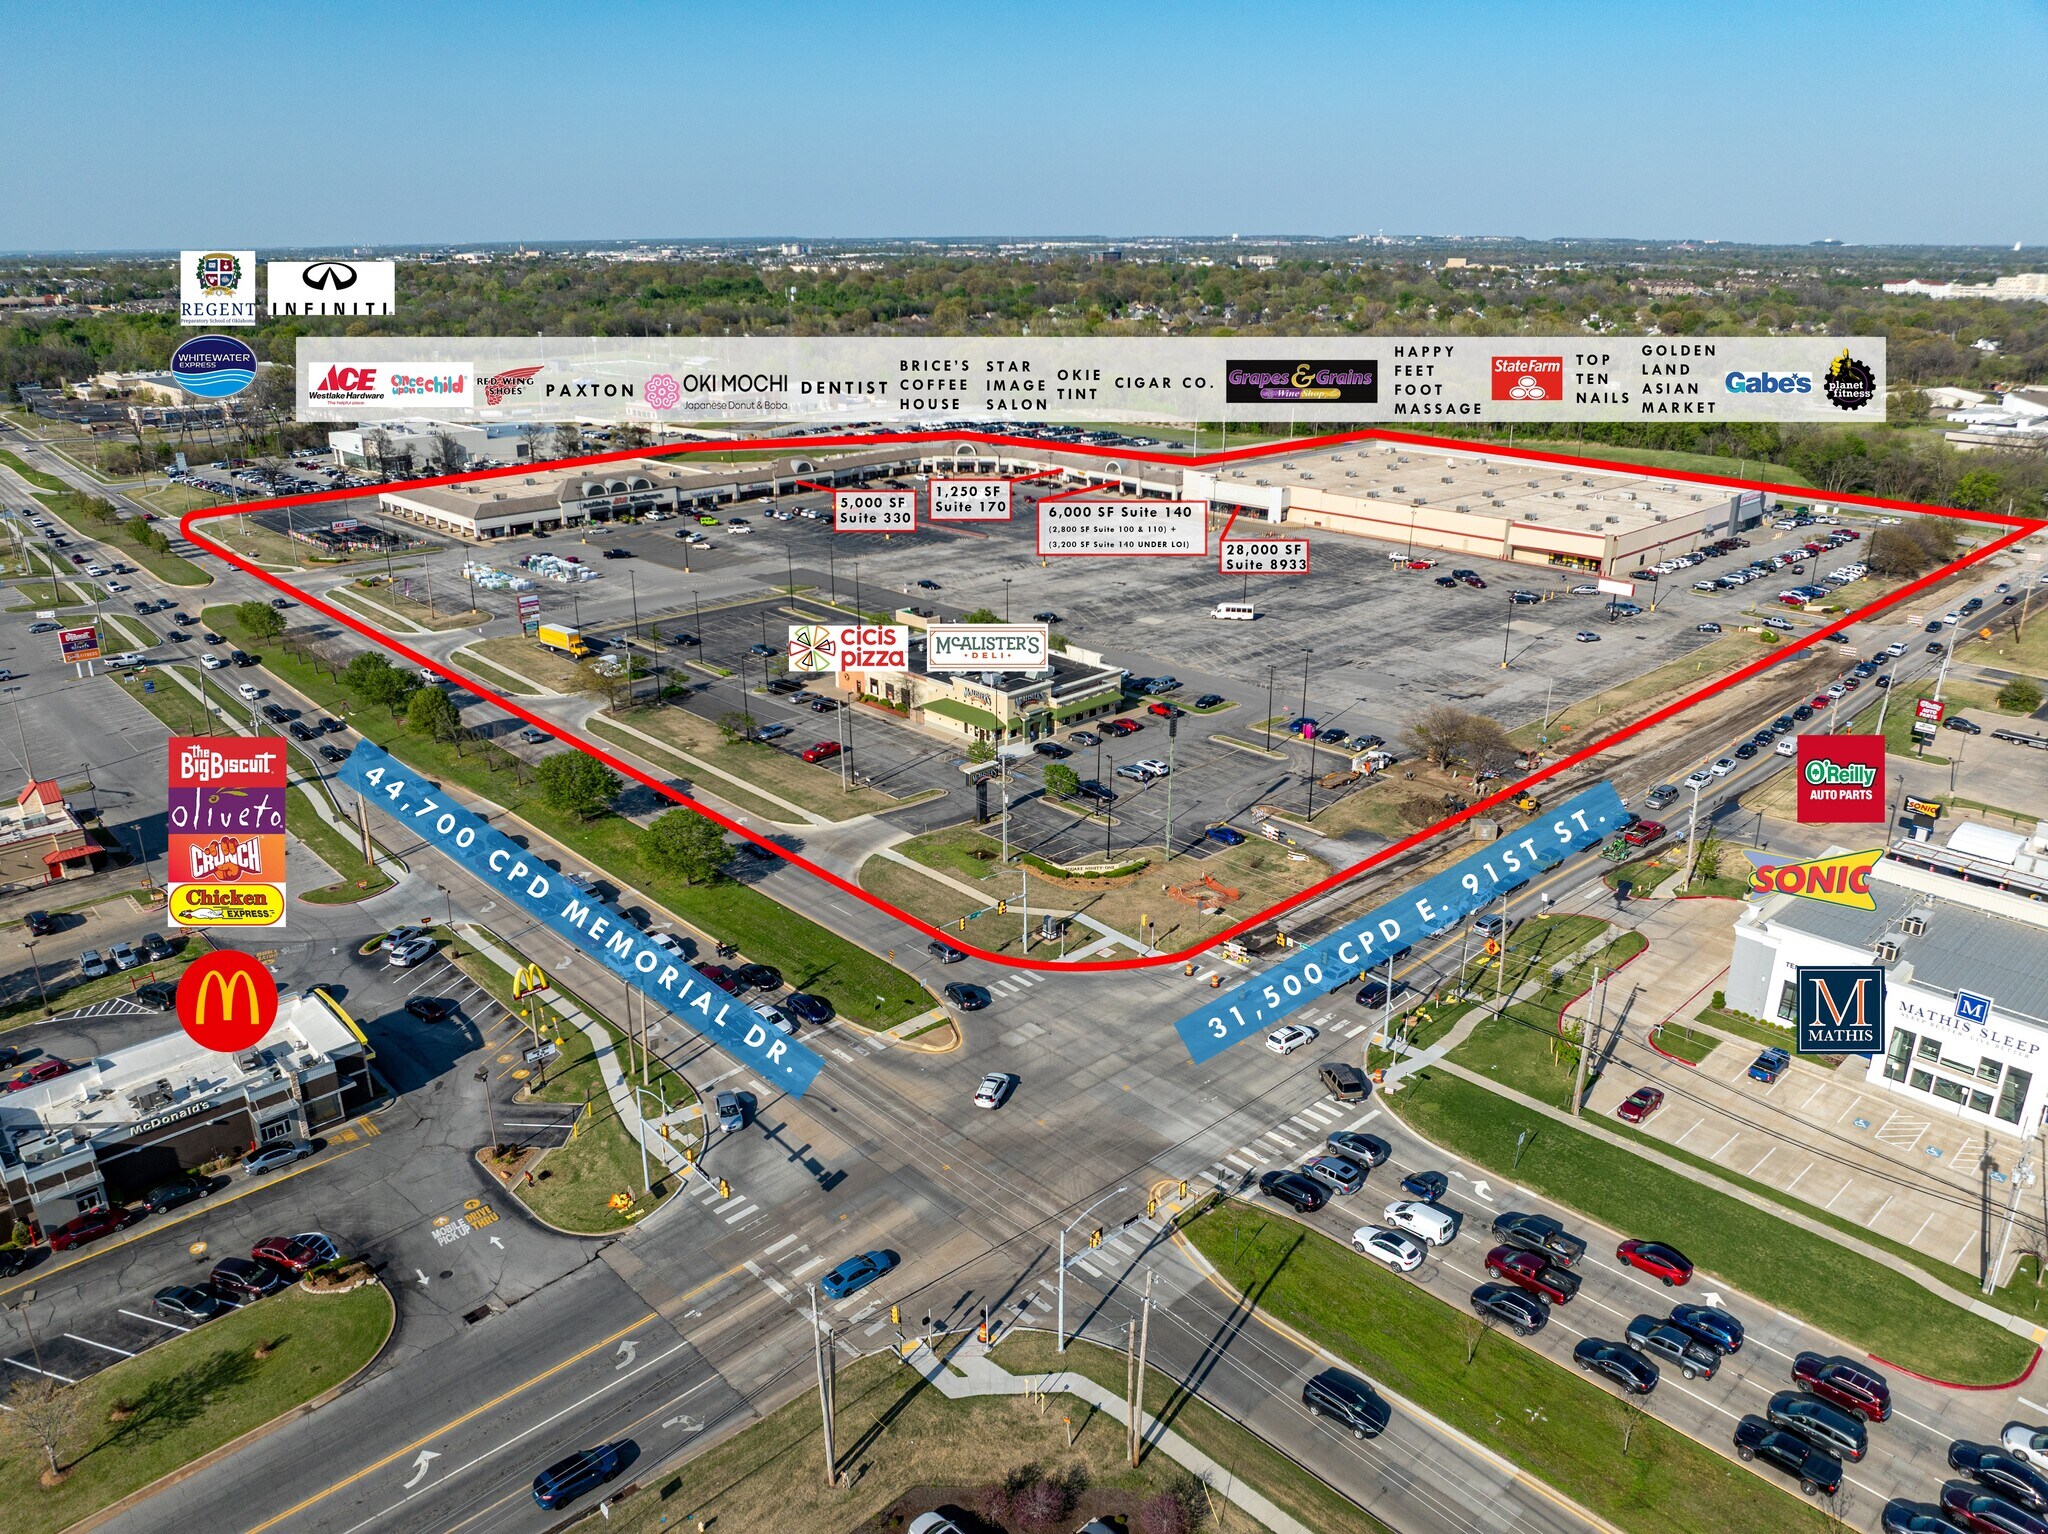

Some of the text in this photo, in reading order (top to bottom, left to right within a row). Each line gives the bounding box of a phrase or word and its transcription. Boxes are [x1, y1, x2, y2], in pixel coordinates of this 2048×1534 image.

[1909, 801, 1937, 813] SONIC
[1960, 999, 1984, 1019] M
[1899, 1000, 2041, 1056] MATHIS SLEEP
[129, 1101, 210, 1136] McDonald's
[464, 1205, 493, 1223] DRIVE
[470, 1212, 500, 1231] THRU
[431, 1218, 467, 1240] MOBILE
[437, 1224, 471, 1247] PICK UP
